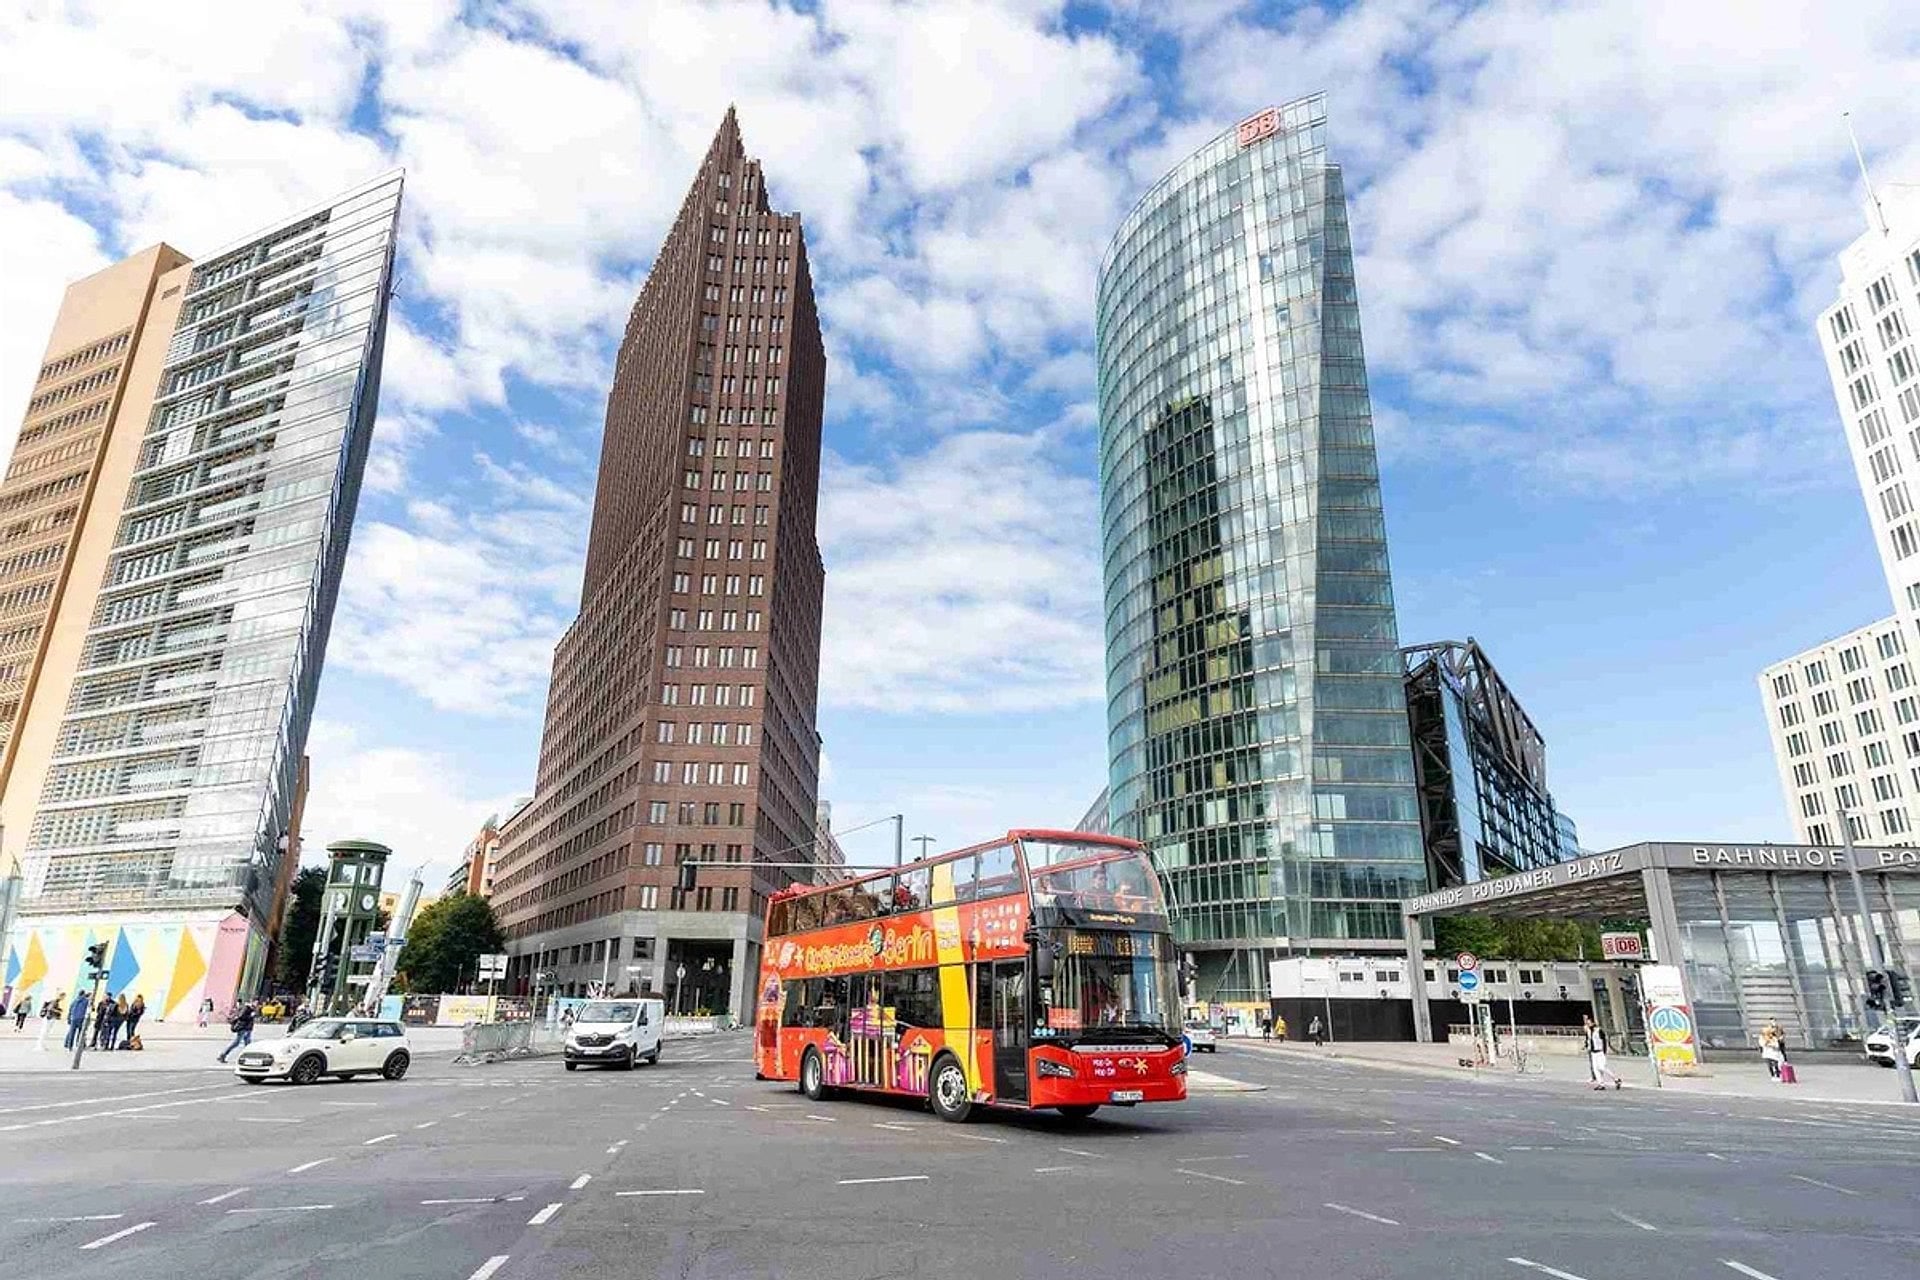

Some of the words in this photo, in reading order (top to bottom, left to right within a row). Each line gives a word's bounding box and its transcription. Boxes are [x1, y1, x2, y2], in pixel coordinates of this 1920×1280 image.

[1240, 111, 1276, 142] DB
[1693, 847, 1845, 865] BAHNHOF
[1412, 889, 1463, 911] BAHNHOF
[1472, 870, 1552, 898] POTSDAMER
[1567, 854, 1624, 878] PLATZ
[1617, 939, 1638, 952] DB
